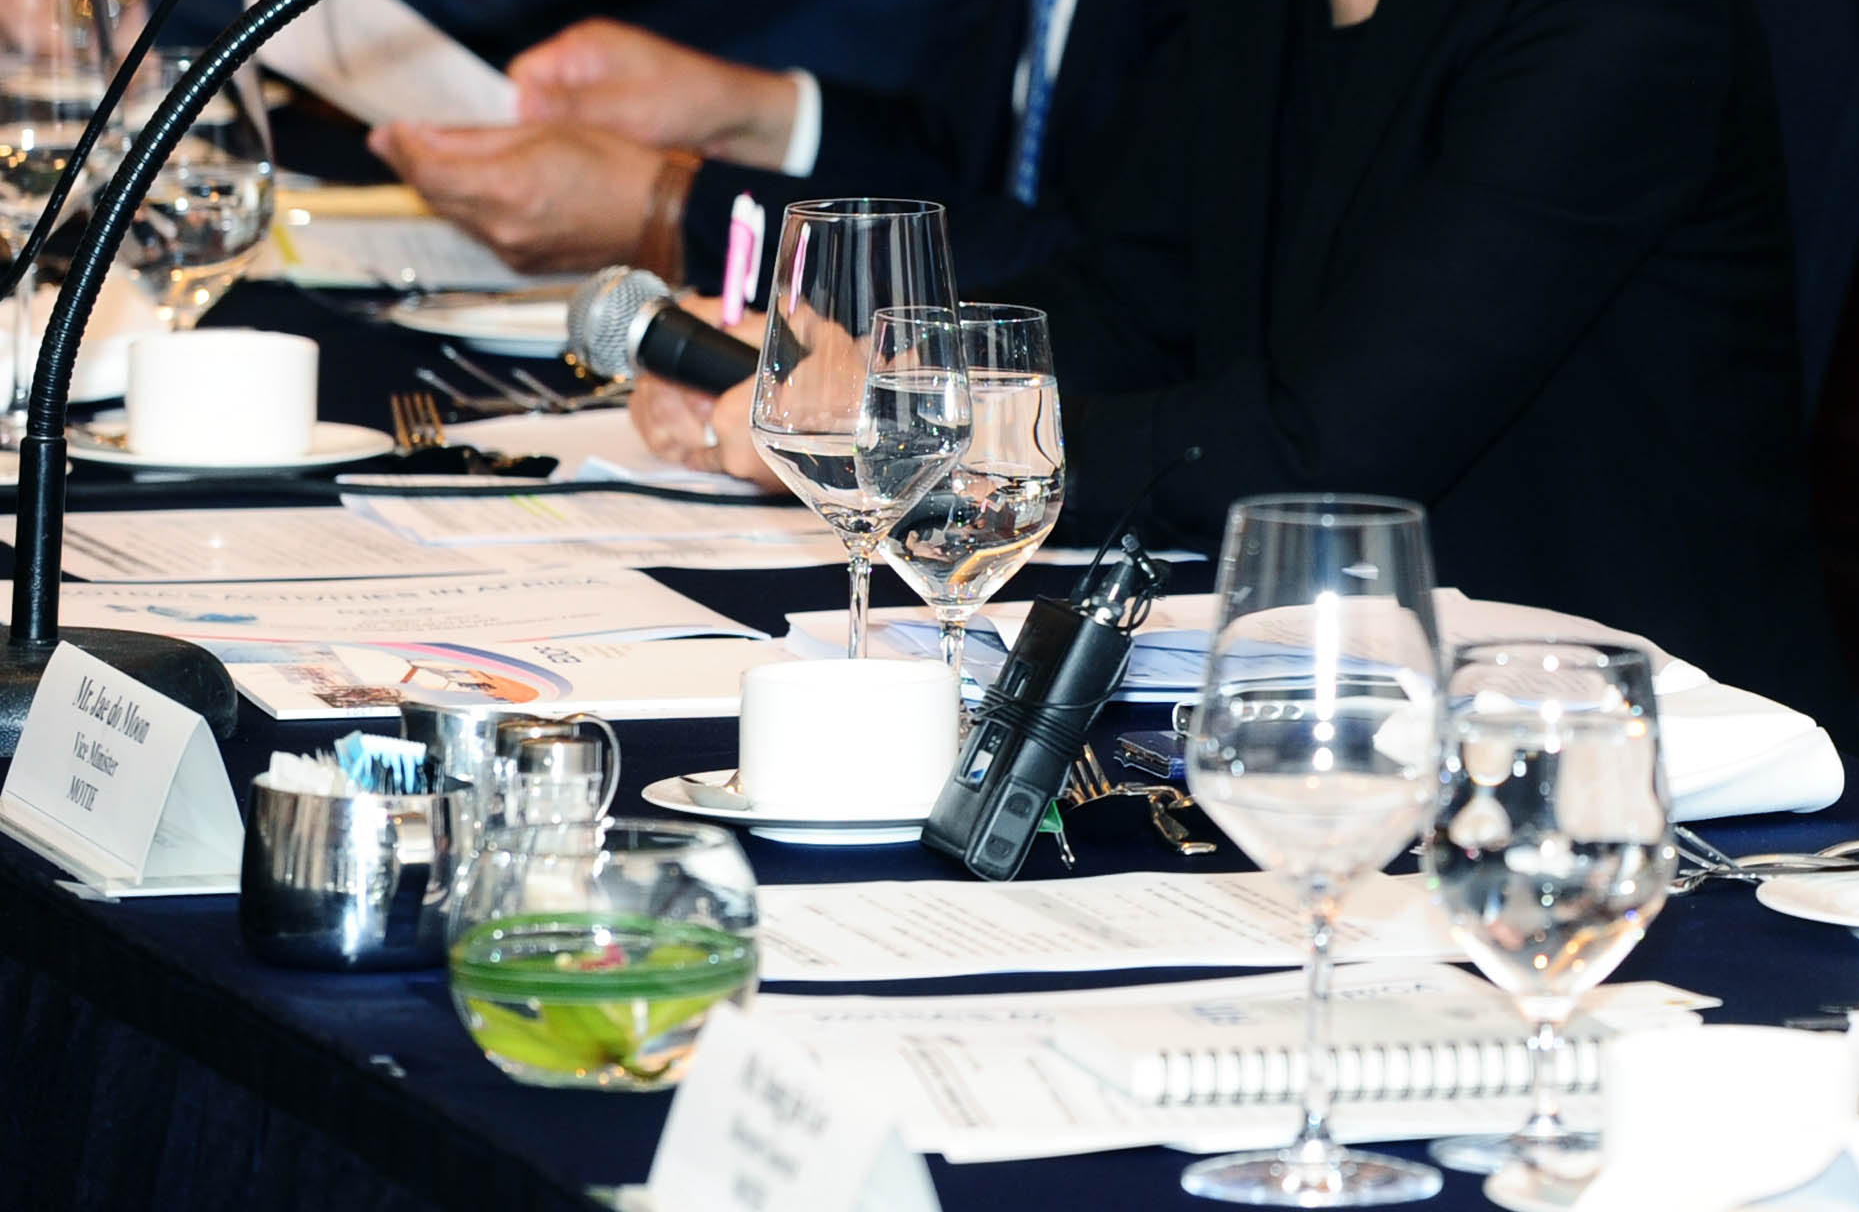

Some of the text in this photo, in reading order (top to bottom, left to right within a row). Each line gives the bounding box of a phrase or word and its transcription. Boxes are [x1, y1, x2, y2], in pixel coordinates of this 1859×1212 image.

[72, 675, 151, 745] Mr. Jae do Moon
[73, 731, 119, 777] Vice Minister
[66, 775, 99, 812] MOTIE
